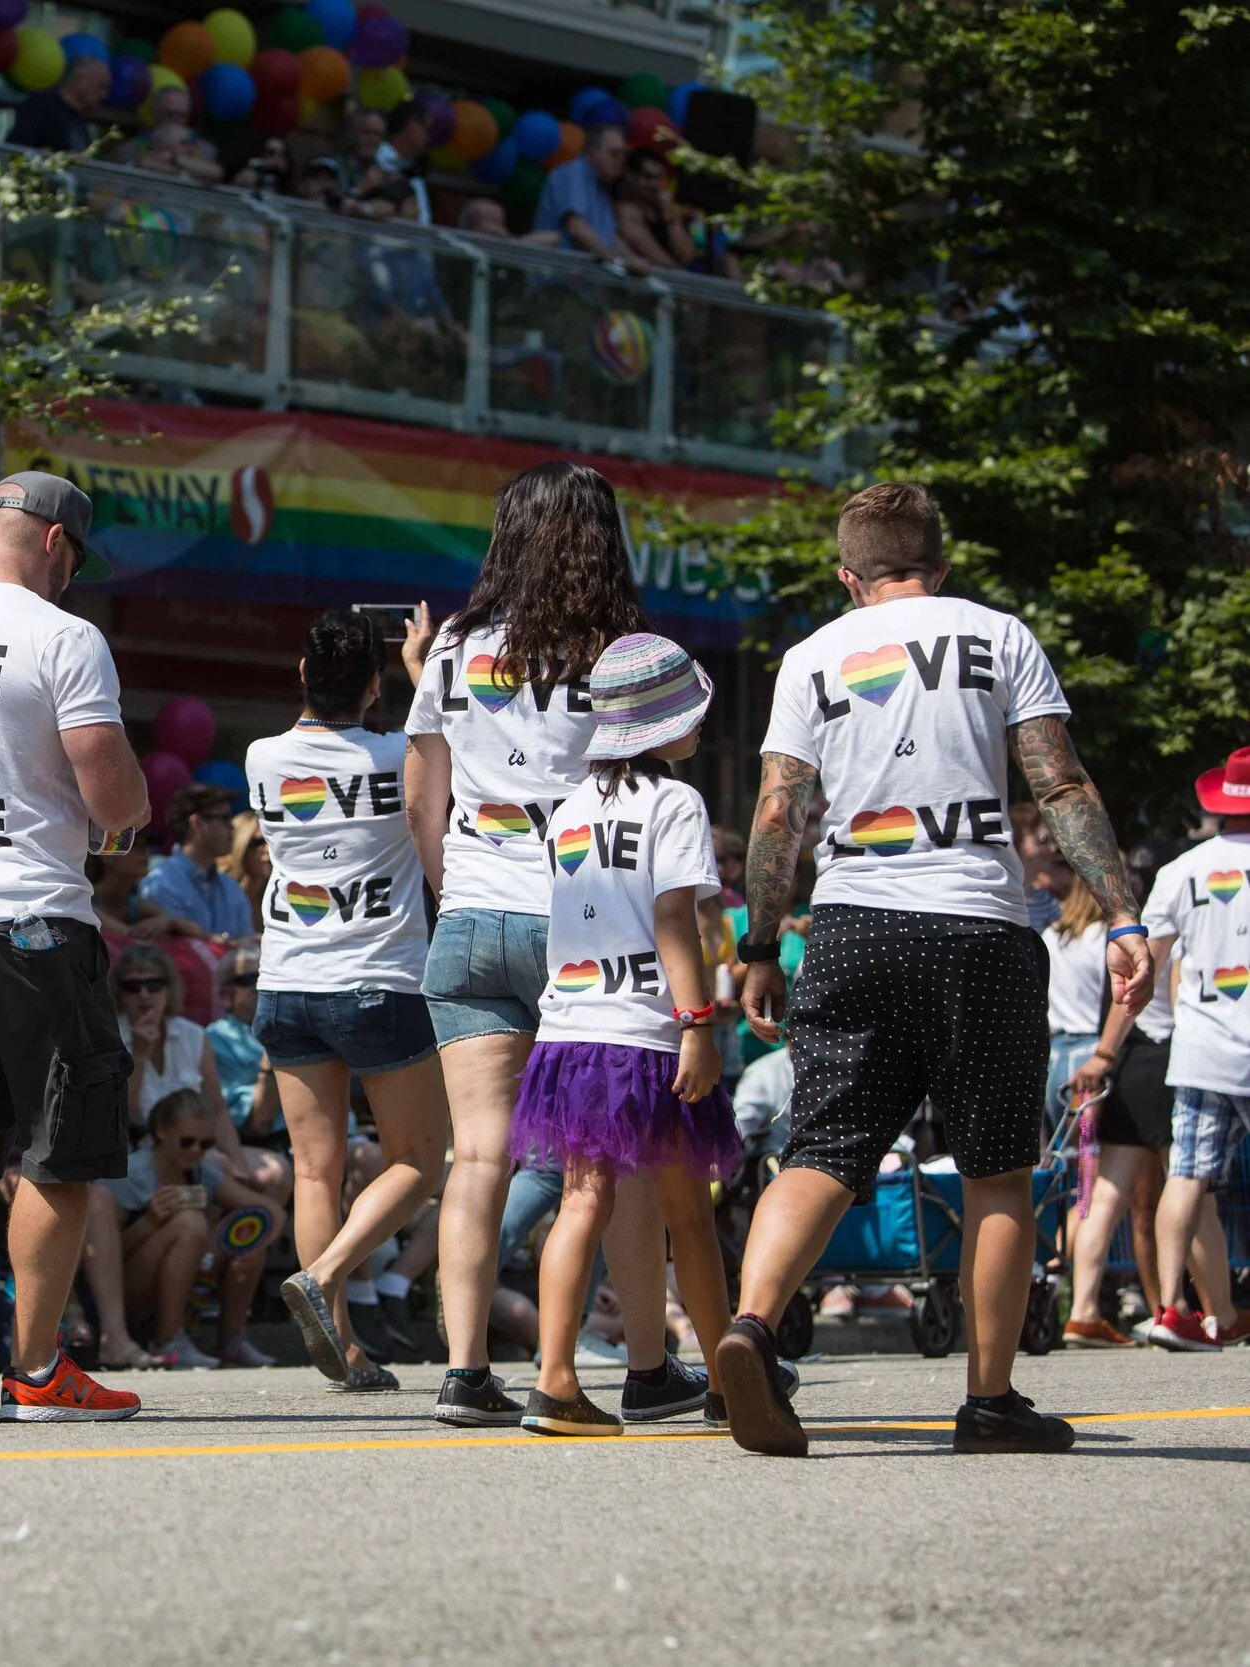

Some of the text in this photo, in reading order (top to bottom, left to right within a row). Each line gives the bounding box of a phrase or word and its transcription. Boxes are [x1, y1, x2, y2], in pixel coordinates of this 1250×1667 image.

[894, 736, 917, 759] is
[508, 748, 527, 766] is
[322, 845, 338, 861] is
[583, 904, 597, 920] is
[548, 951, 660, 1000] OVE
